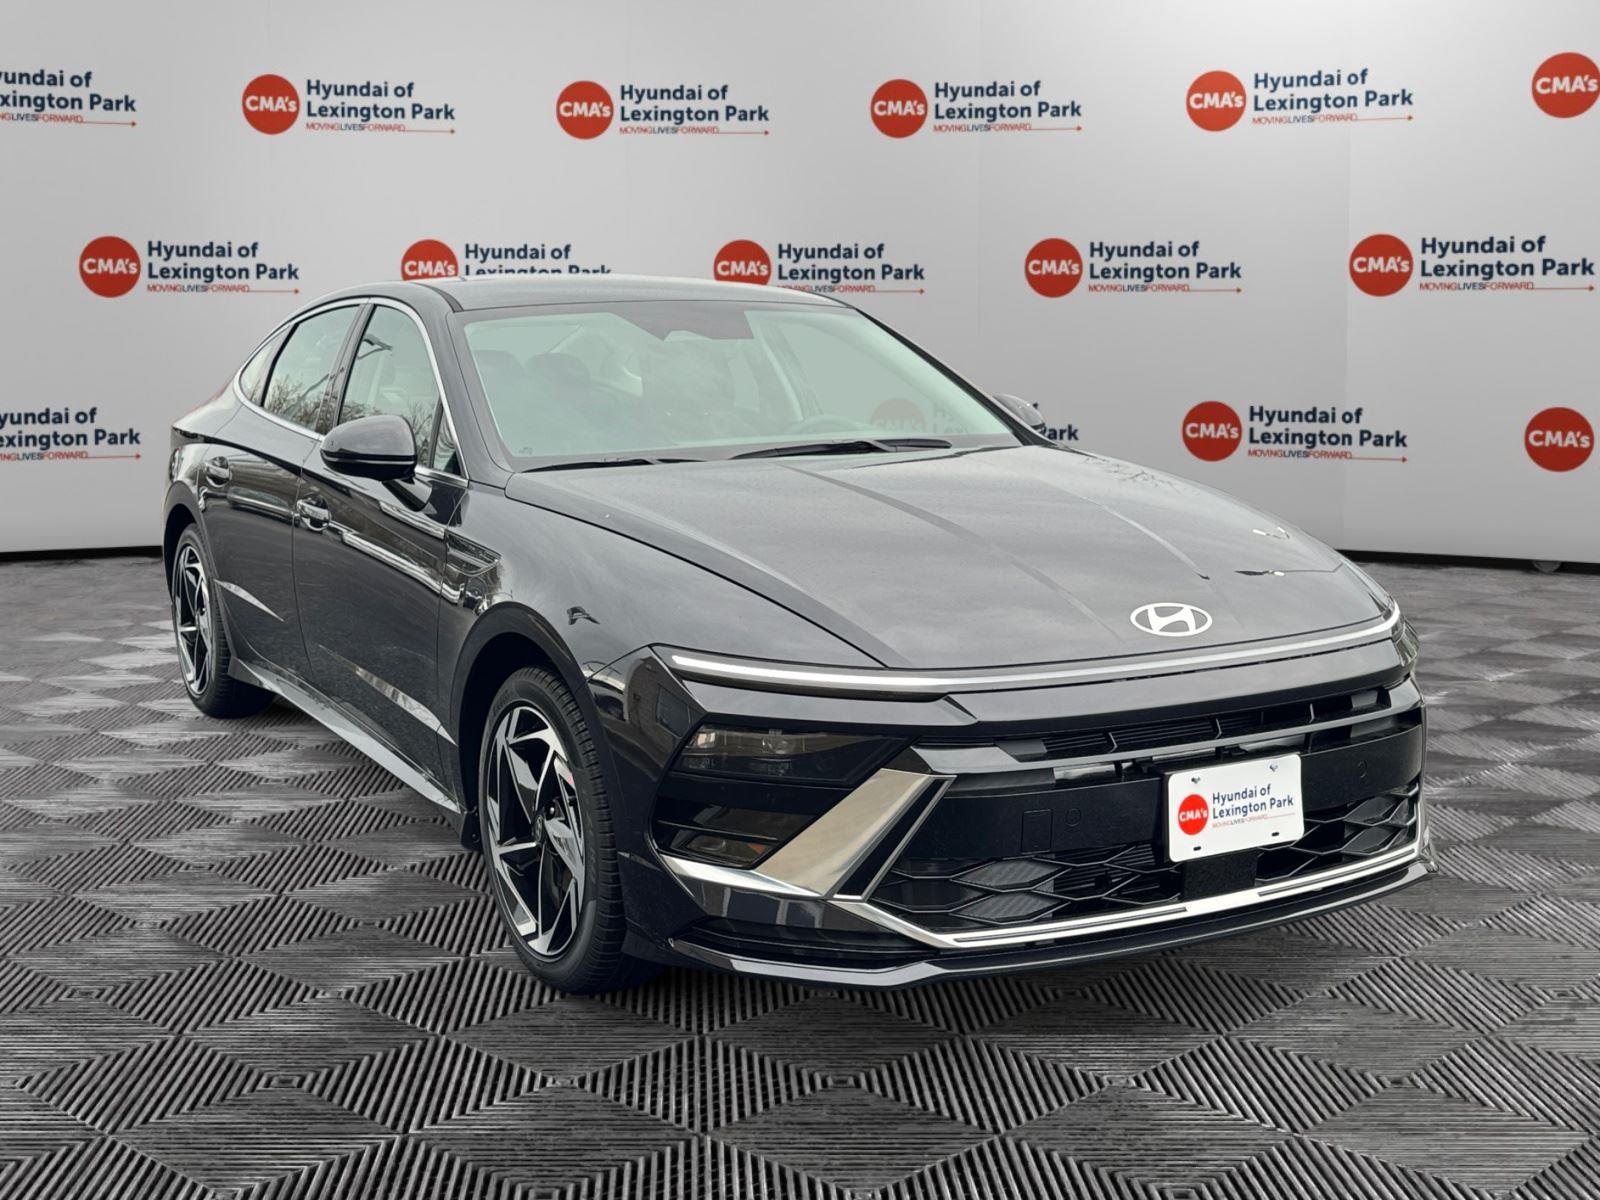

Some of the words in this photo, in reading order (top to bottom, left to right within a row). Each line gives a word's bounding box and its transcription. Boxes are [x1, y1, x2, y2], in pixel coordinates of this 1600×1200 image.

[0, 69, 65, 86] undai
[69, 71, 93, 87] of
[1253, 70, 1342, 91] Hyundai
[1346, 68, 1369, 85] of
[1535, 75, 1599, 94] CMA's
[306, 79, 389, 99] Hyundai
[393, 82, 415, 97] of
[620, 85, 703, 103] Hyundai
[707, 85, 729, 100] of
[934, 81, 1015, 101] Hyundai
[1019, 80, 1041, 96] of
[0, 90, 83, 112] xington
[89, 94, 137, 112] Park
[245, 96, 298, 112] CMA's
[559, 102, 612, 117] CMA's
[873, 101, 926, 115] CMA's
[1188, 92, 1245, 110] CMA's
[1253, 94, 1358, 113] Lexington
[1364, 89, 1414, 107] Park
[306, 101, 406, 122] Lexington
[411, 103, 456, 119] Park
[620, 106, 720, 125] Lexington
[725, 105, 770, 121] Park
[934, 103, 1032, 122] Lexington
[1037, 101, 1082, 117] Park
[147, 241, 233, 261] Hyundai
[237, 242, 259, 258] of
[464, 244, 546, 263] Hyundai
[550, 244, 572, 259] of
[777, 243, 859, 263] Hyundai
[863, 243, 885, 259] of
[1089, 241, 1173, 261] Hyundai
[1177, 241, 1200, 257] of
[1421, 236, 1515, 257] Hyundai
[1520, 236, 1547, 253] of
[82, 258, 138, 274] CMA's
[147, 262, 250, 283] Lexington
[255, 263, 300, 279] Park
[404, 261, 457, 277] CMA's
[716, 261, 769, 276] CMA's
[777, 264, 876, 284] Lexington
[881, 264, 925, 280] Park
[1027, 260, 1080, 275] CMA's
[1089, 263, 1190, 282] Lexington
[1195, 262, 1242, 278] Park
[1351, 257, 1411, 272] CMA's
[1420, 260, 1535, 281] Lexington
[1541, 258, 1595, 275] Park
[0, 408, 70, 429] yundai
[74, 407, 98, 424] of
[1249, 406, 1337, 426] Hyundai
[1341, 408, 1364, 424] of
[0, 430, 88, 450] xington
[94, 428, 141, 445] Park
[1184, 423, 1240, 440] CMA's
[1248, 428, 1353, 449] Lexington
[1358, 430, 1408, 447] Park
[1528, 430, 1591, 448] CMA's
[1213, 786, 1257, 806] Hyundai
[1260, 784, 1271, 796] of
[1179, 809, 1208, 823] CMA's
[1213, 801, 1266, 819] Lexington
[1270, 795, 1293, 808] Park
